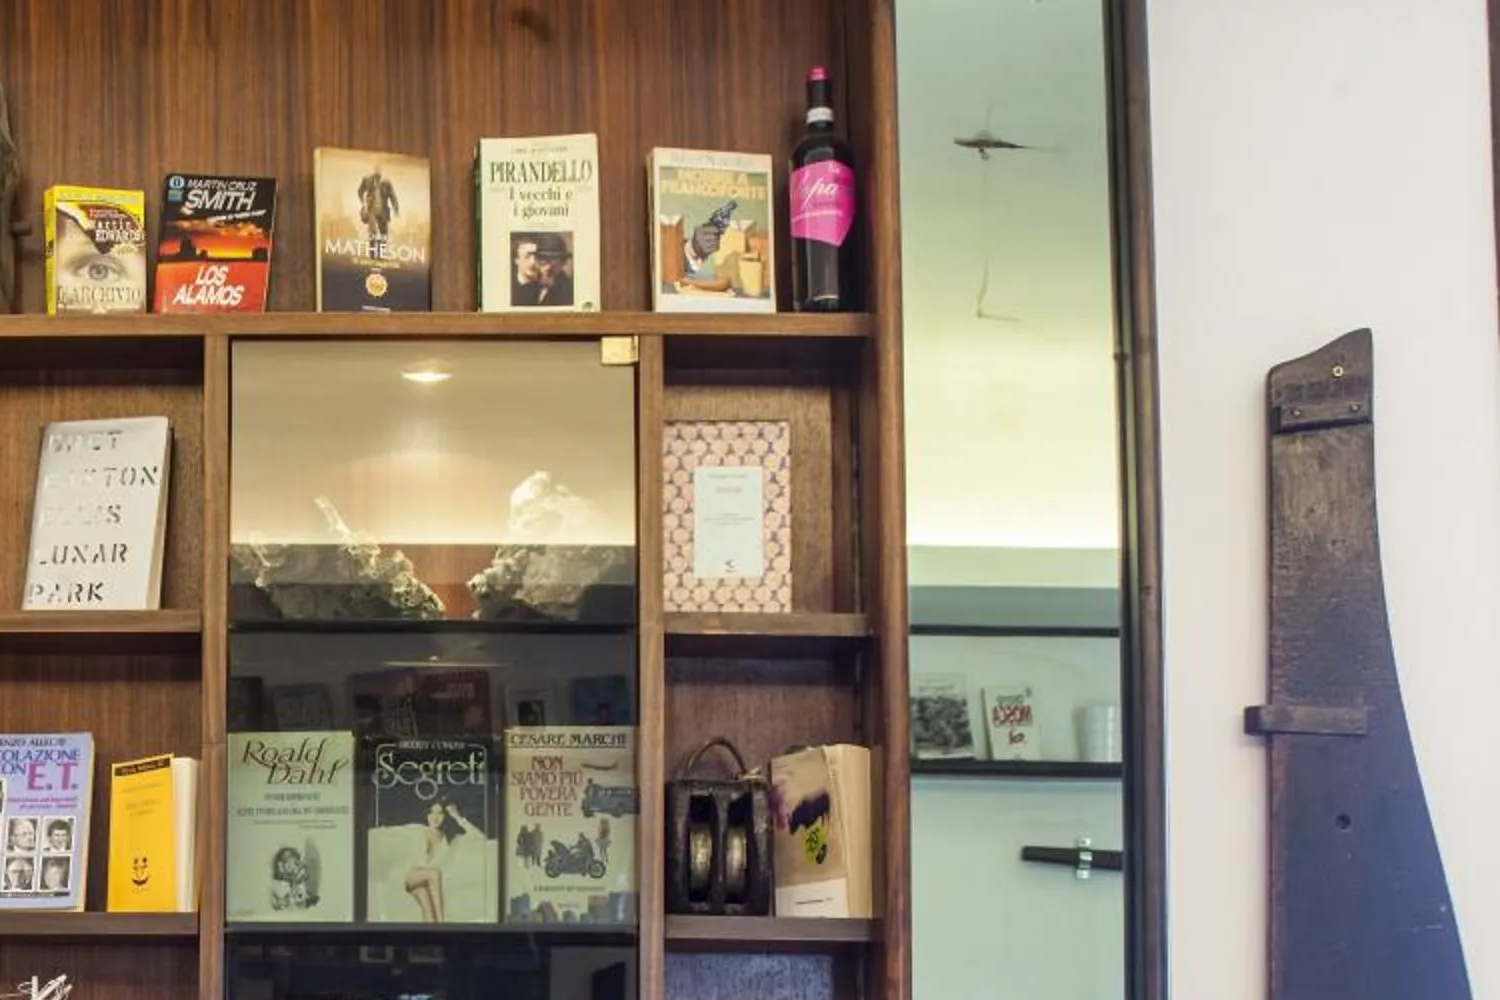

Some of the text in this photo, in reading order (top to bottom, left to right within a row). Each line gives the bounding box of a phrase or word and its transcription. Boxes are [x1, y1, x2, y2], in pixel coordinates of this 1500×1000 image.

[490, 159, 593, 183] PIRANDELLO
[187, 179, 258, 191] MARTIN CRUZ
[519, 186, 562, 201] vecchi
[184, 188, 258, 211] SMITH
[522, 202, 569, 219] giovani
[325, 238, 426, 265] MATHESON
[195, 264, 229, 286] LOS
[172, 283, 245, 306] ALAMOS
[509, 733, 627, 746] CESARE MARCHI
[243, 737, 331, 768] Roald
[267, 757, 349, 785] Dahl
[531, 755, 563, 770] NON
[373, 750, 486, 800] Segreti
[511, 772, 559, 786] SIAMO
[519, 786, 579, 802] POVERA
[524, 803, 574, 818] GENTE
